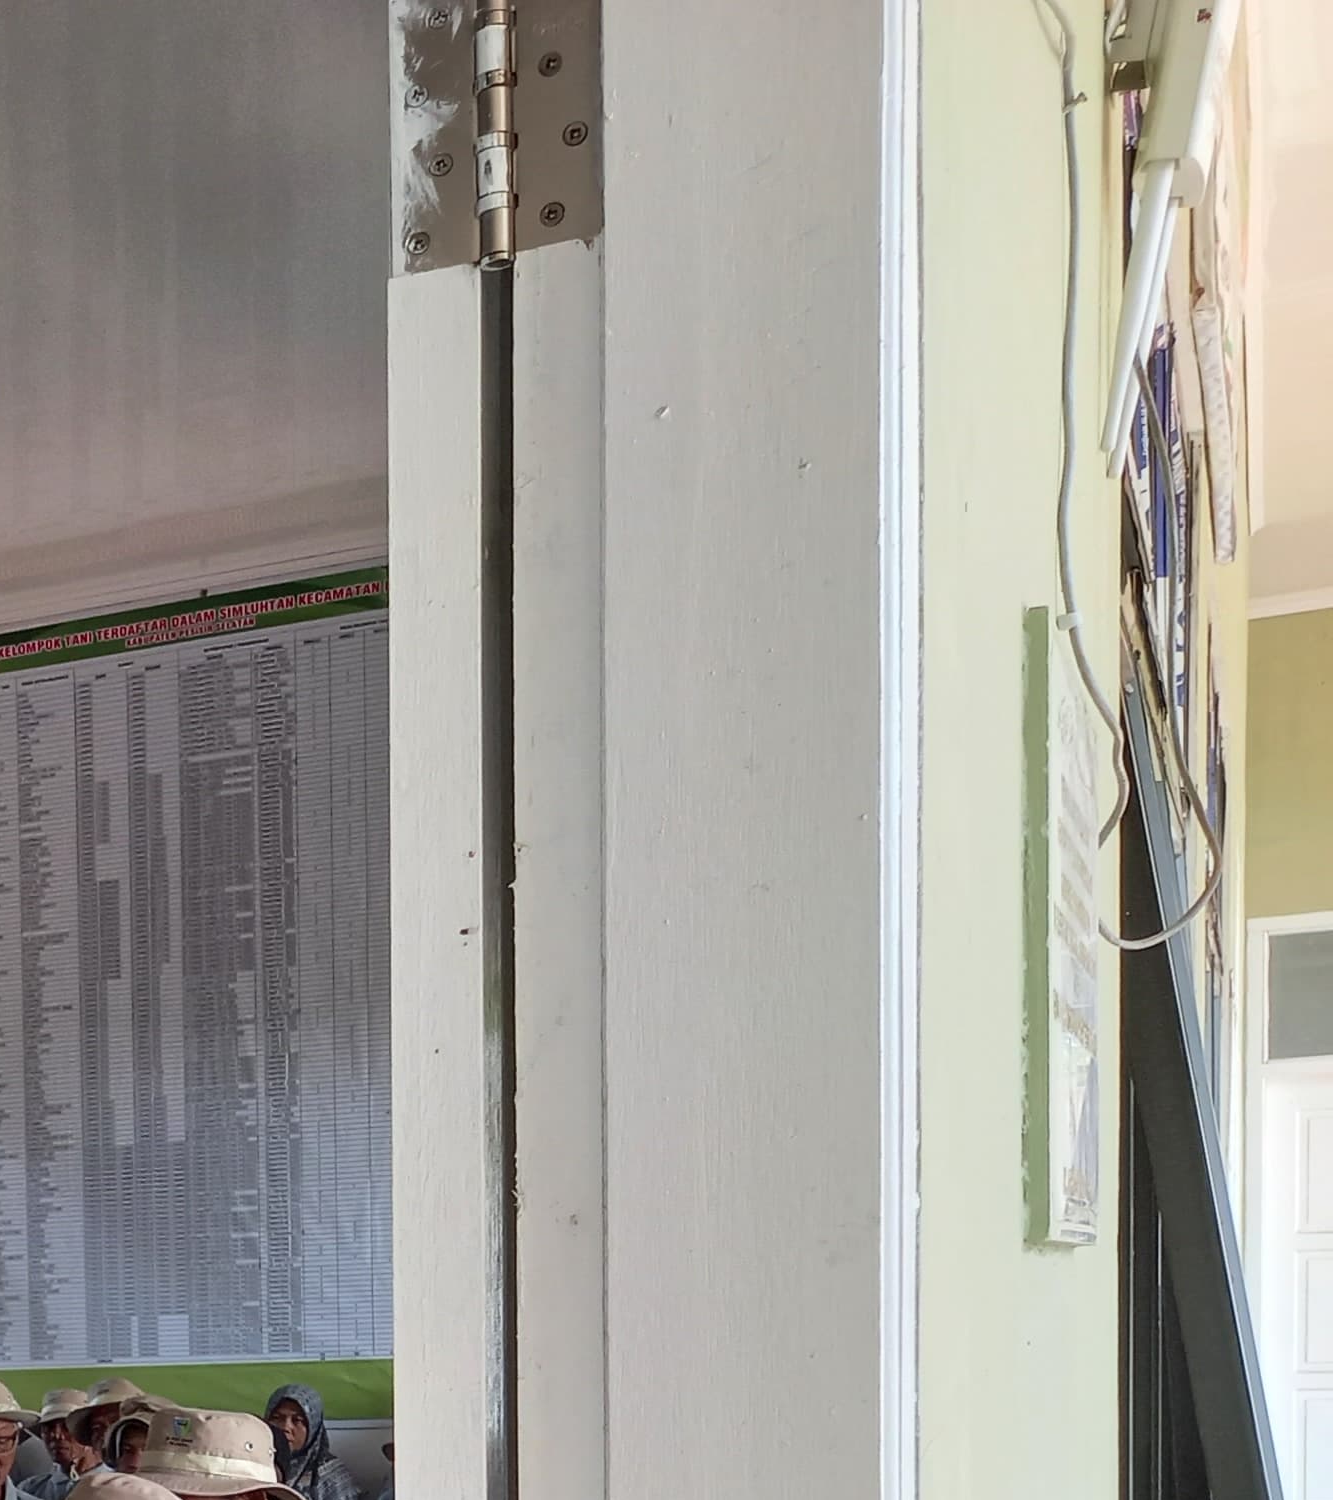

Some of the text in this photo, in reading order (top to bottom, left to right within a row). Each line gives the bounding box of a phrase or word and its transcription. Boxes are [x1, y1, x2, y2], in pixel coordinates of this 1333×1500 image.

[65, 631, 93, 648] TANI
[96, 617, 169, 643] TERDAFTAR
[171, 609, 215, 631] DALAM
[218, 595, 295, 621] SIMLUHTAN
[297, 581, 380, 607] KECAMATAN
